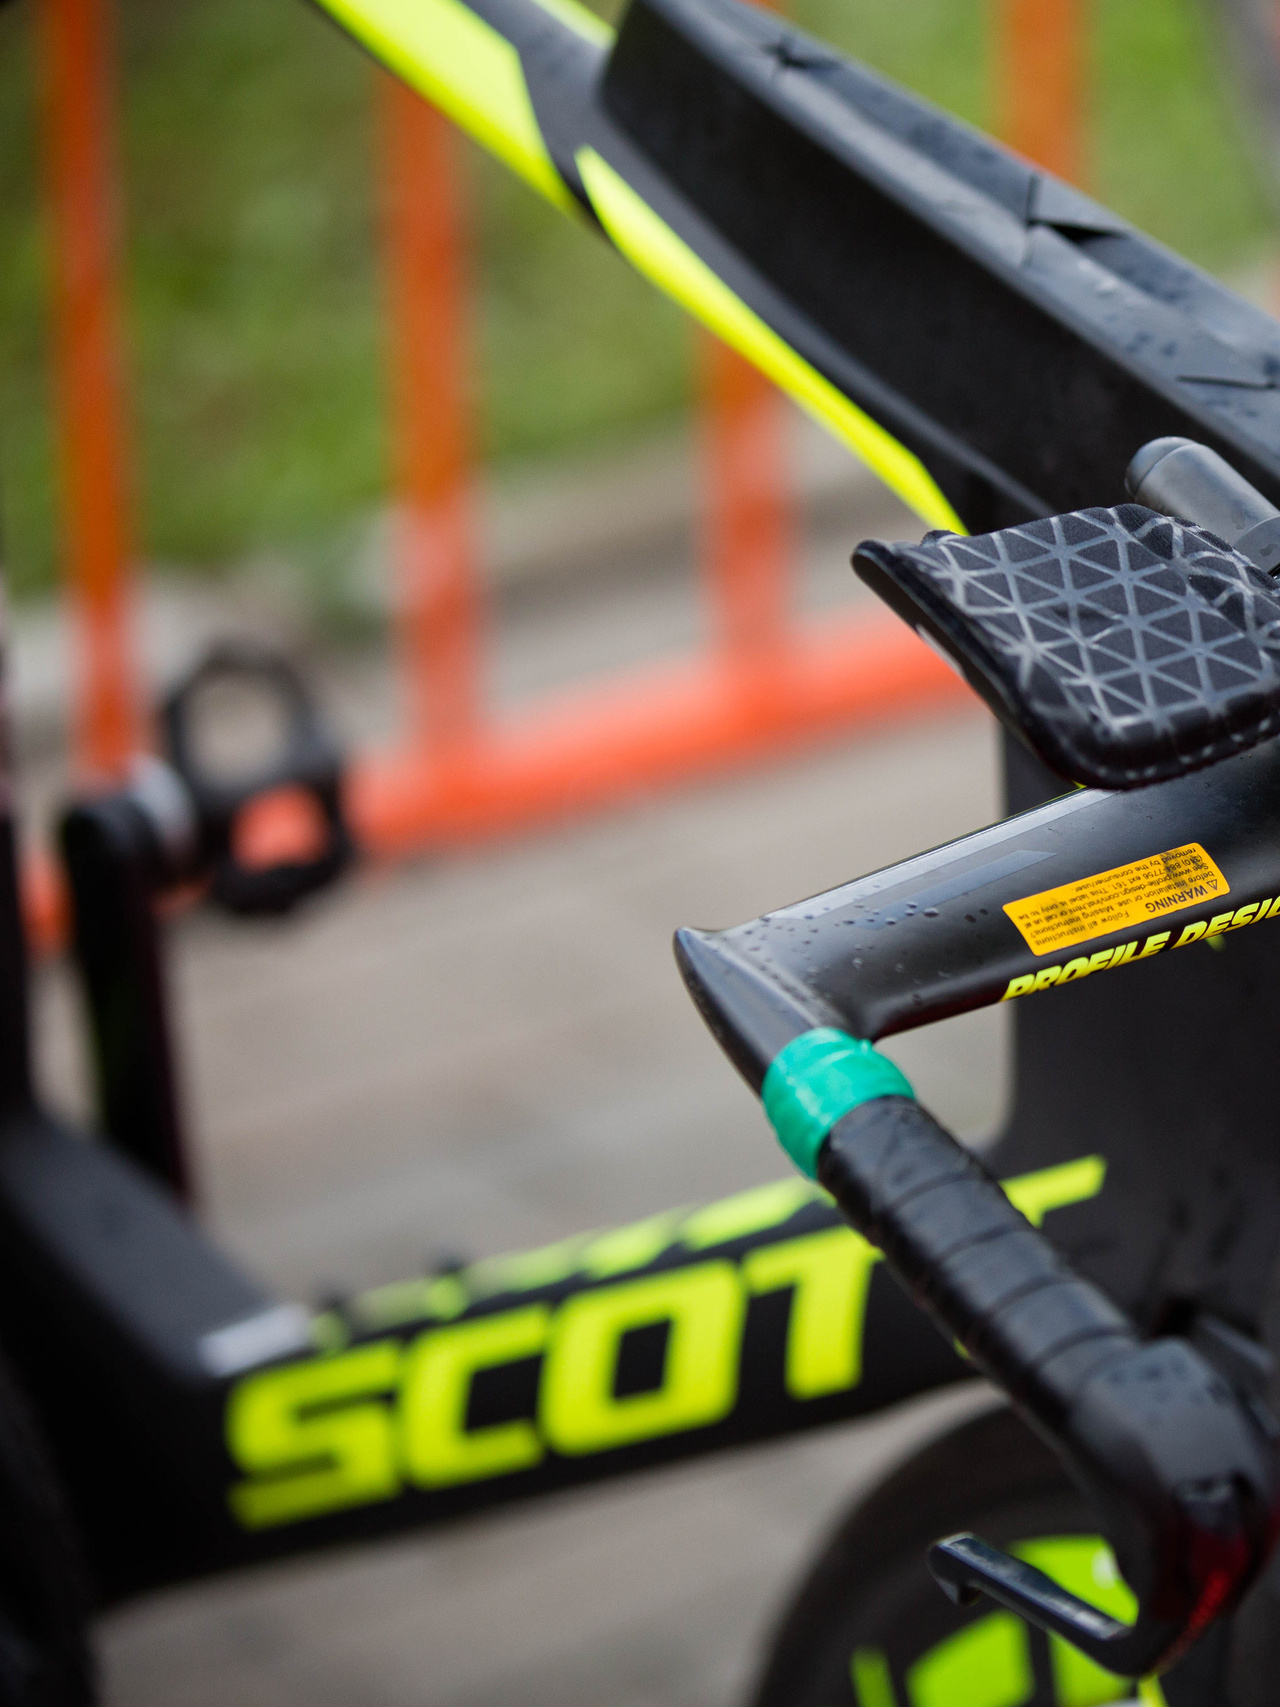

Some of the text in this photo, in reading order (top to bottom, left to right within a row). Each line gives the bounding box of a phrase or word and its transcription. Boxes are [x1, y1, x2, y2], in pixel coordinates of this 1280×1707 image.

[1160, 847, 1198, 864] removed
[1133, 863, 1149, 873] the
[1147, 858, 1161, 867] by
[1191, 862, 1209, 872] See
[1127, 875, 1142, 884] ext
[1186, 870, 1215, 884] before
[1088, 886, 1109, 897] This
[1142, 879, 1188, 899] installation
[1067, 893, 1089, 905] label
[1142, 884, 1208, 913] WARNING
[1029, 909, 1040, 917] to
[1038, 901, 1059, 913] only
[1079, 903, 1114, 920] Missing
[1099, 910, 1130, 925] Follow
[1086, 920, 1099, 929] all
[999, 930, 1171, 1003] PROFILE
[228, 1155, 1107, 1531] SCOT
